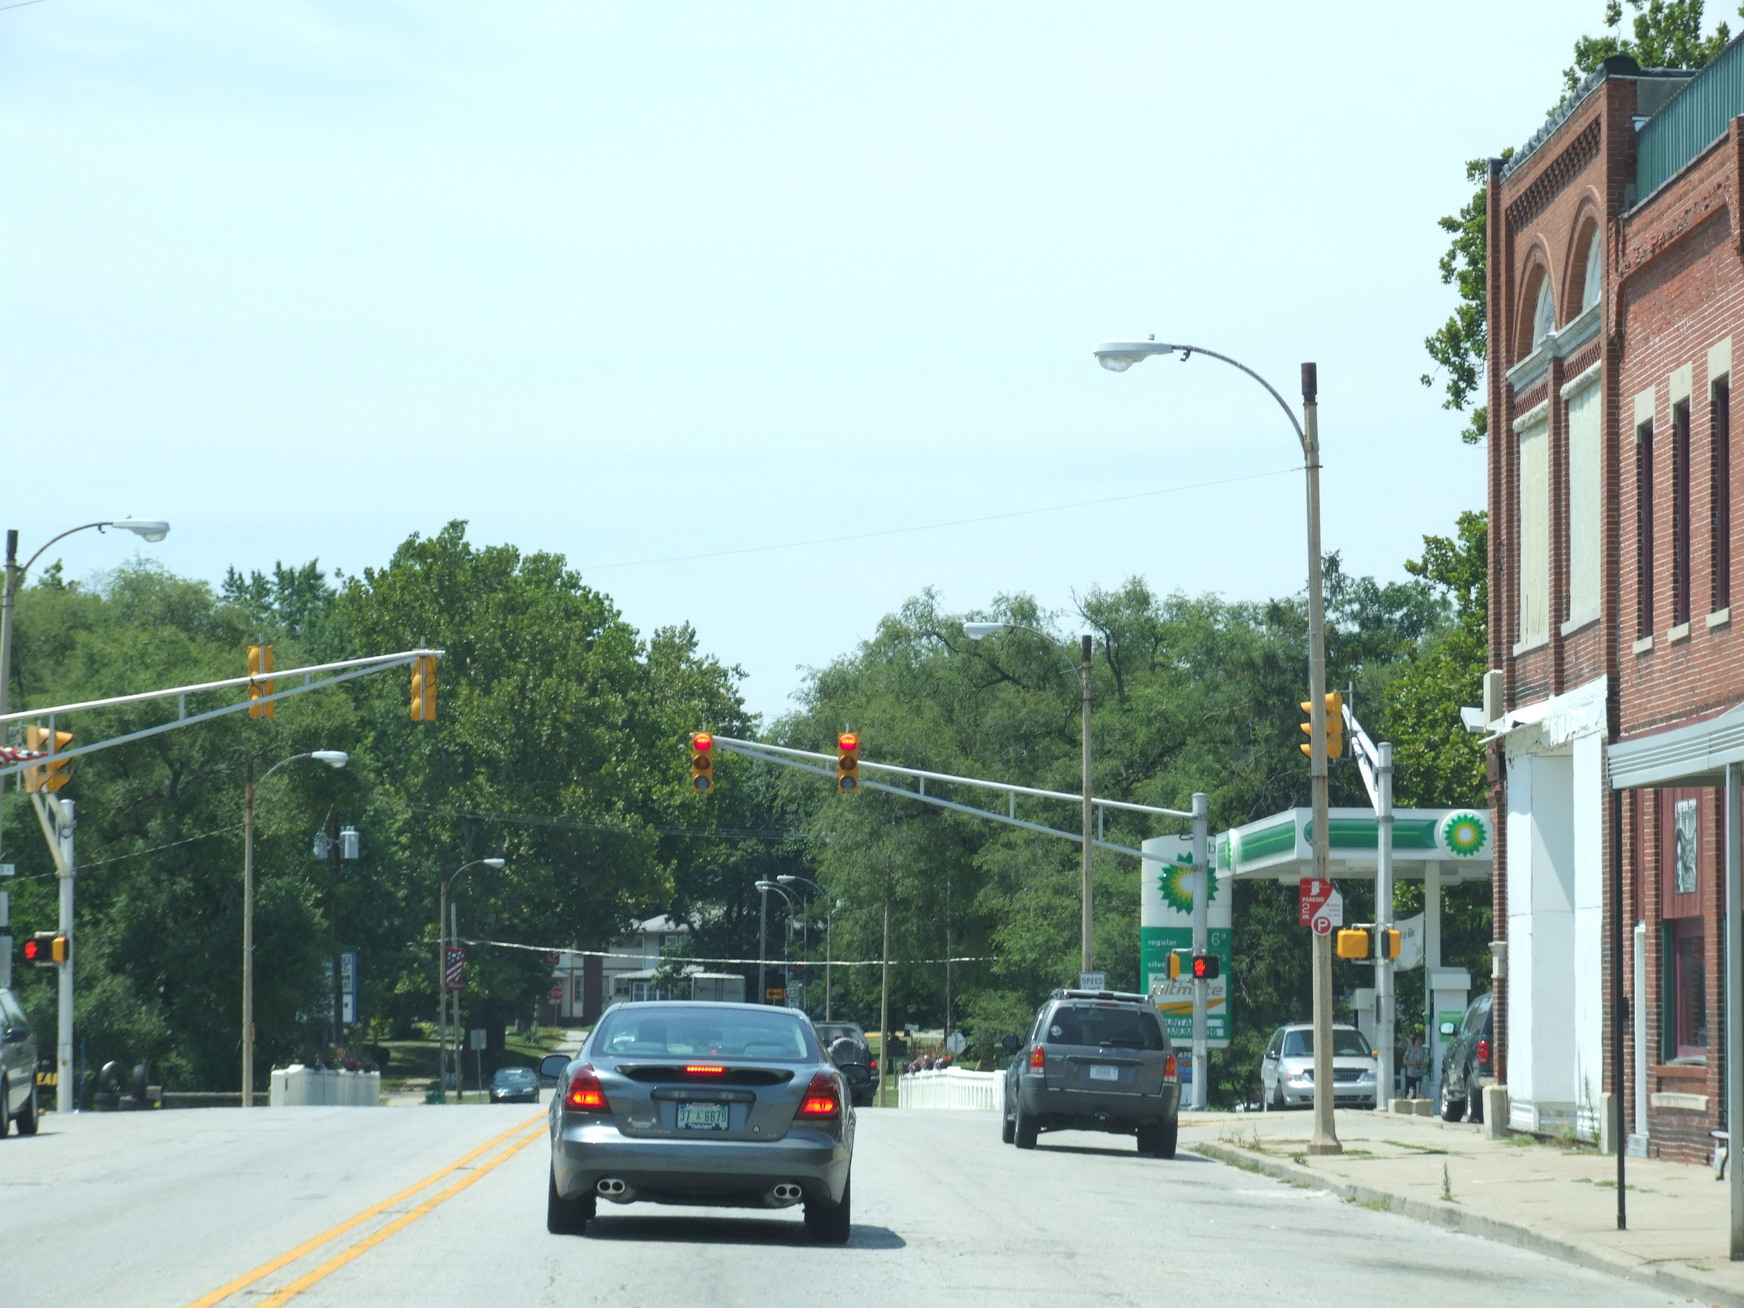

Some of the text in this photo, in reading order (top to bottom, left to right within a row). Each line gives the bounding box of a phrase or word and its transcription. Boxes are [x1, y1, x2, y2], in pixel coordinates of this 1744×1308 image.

[1302, 903, 1310, 914] 2
[1318, 919, 1328, 931] P
[1148, 939, 1177, 947] regular
[1081, 977, 1104, 985] SPEED
[696, 1112, 701, 1120] A
